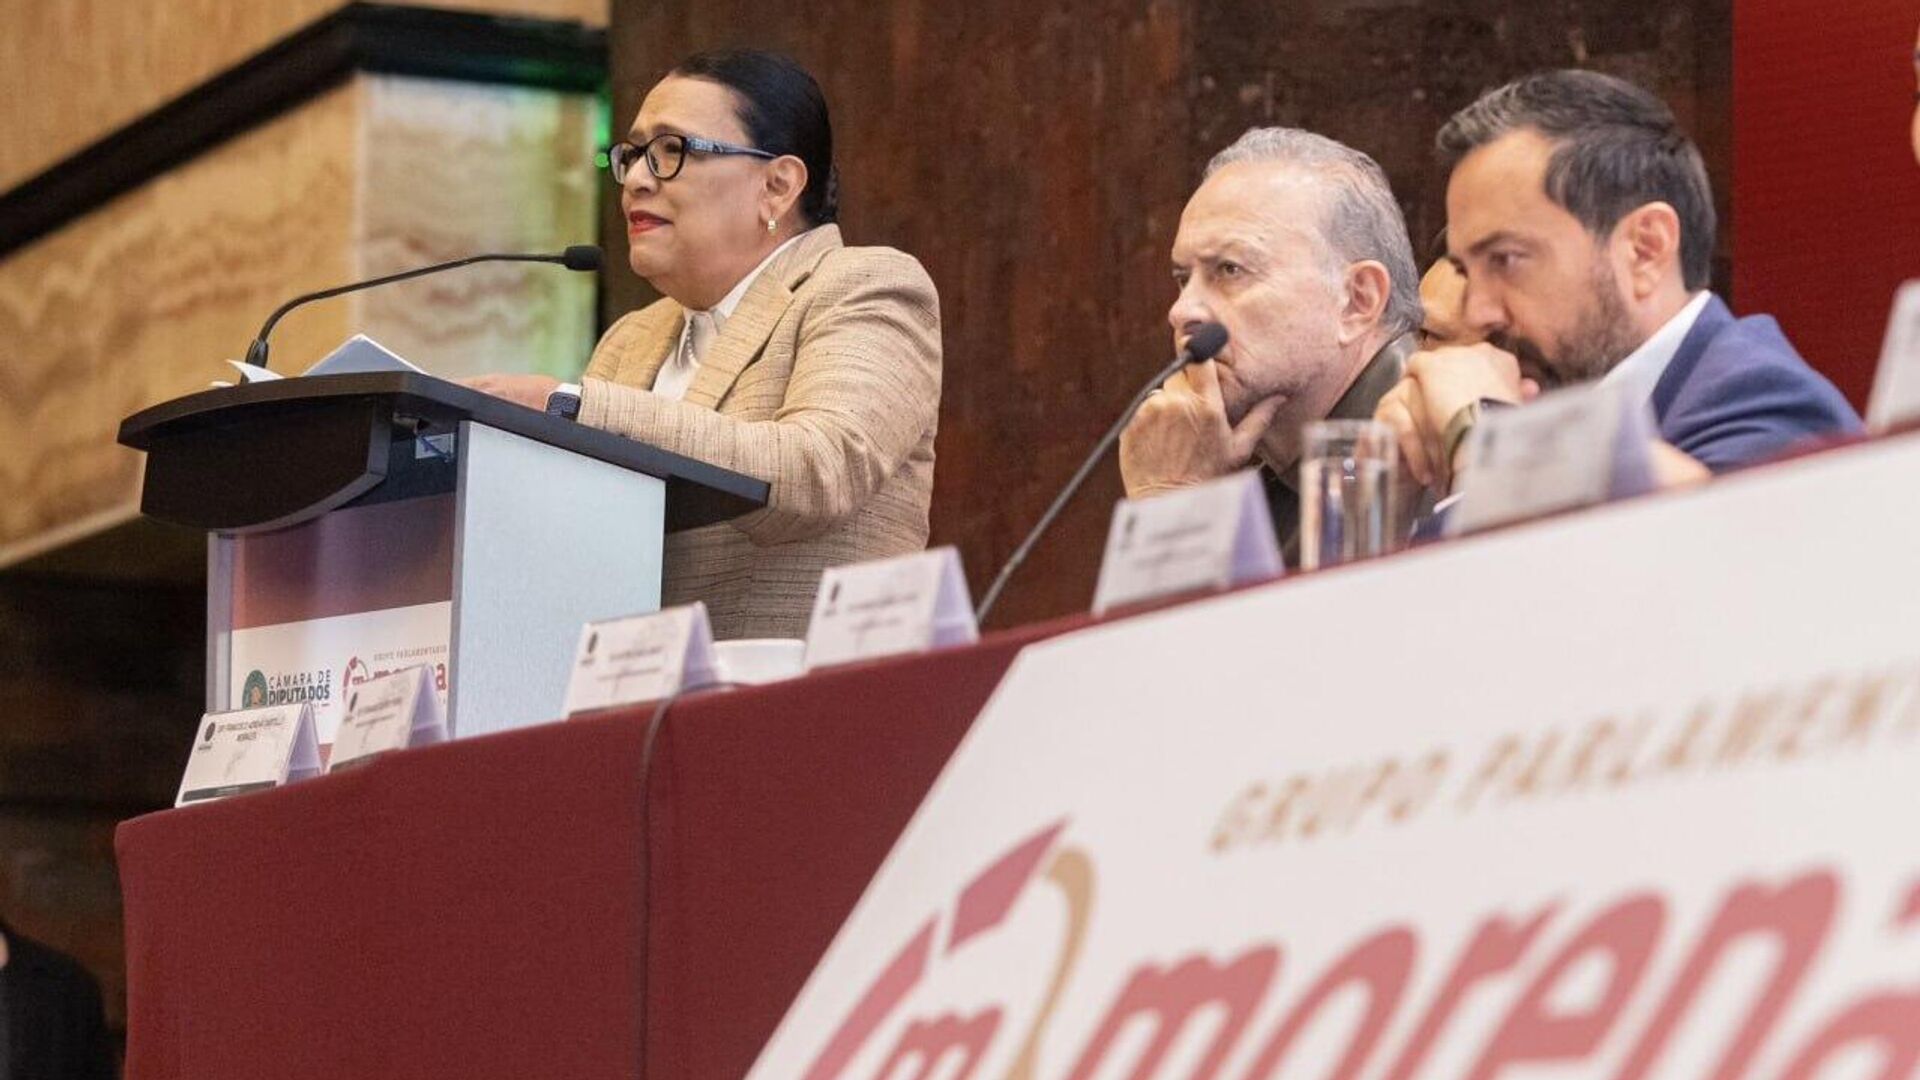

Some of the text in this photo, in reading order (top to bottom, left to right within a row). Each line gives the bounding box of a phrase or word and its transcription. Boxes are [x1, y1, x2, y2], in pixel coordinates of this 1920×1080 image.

[318, 669, 331, 684] DE
[268, 683, 330, 706] DIPUTADOS
[1206, 747, 1452, 851] GRUPO
